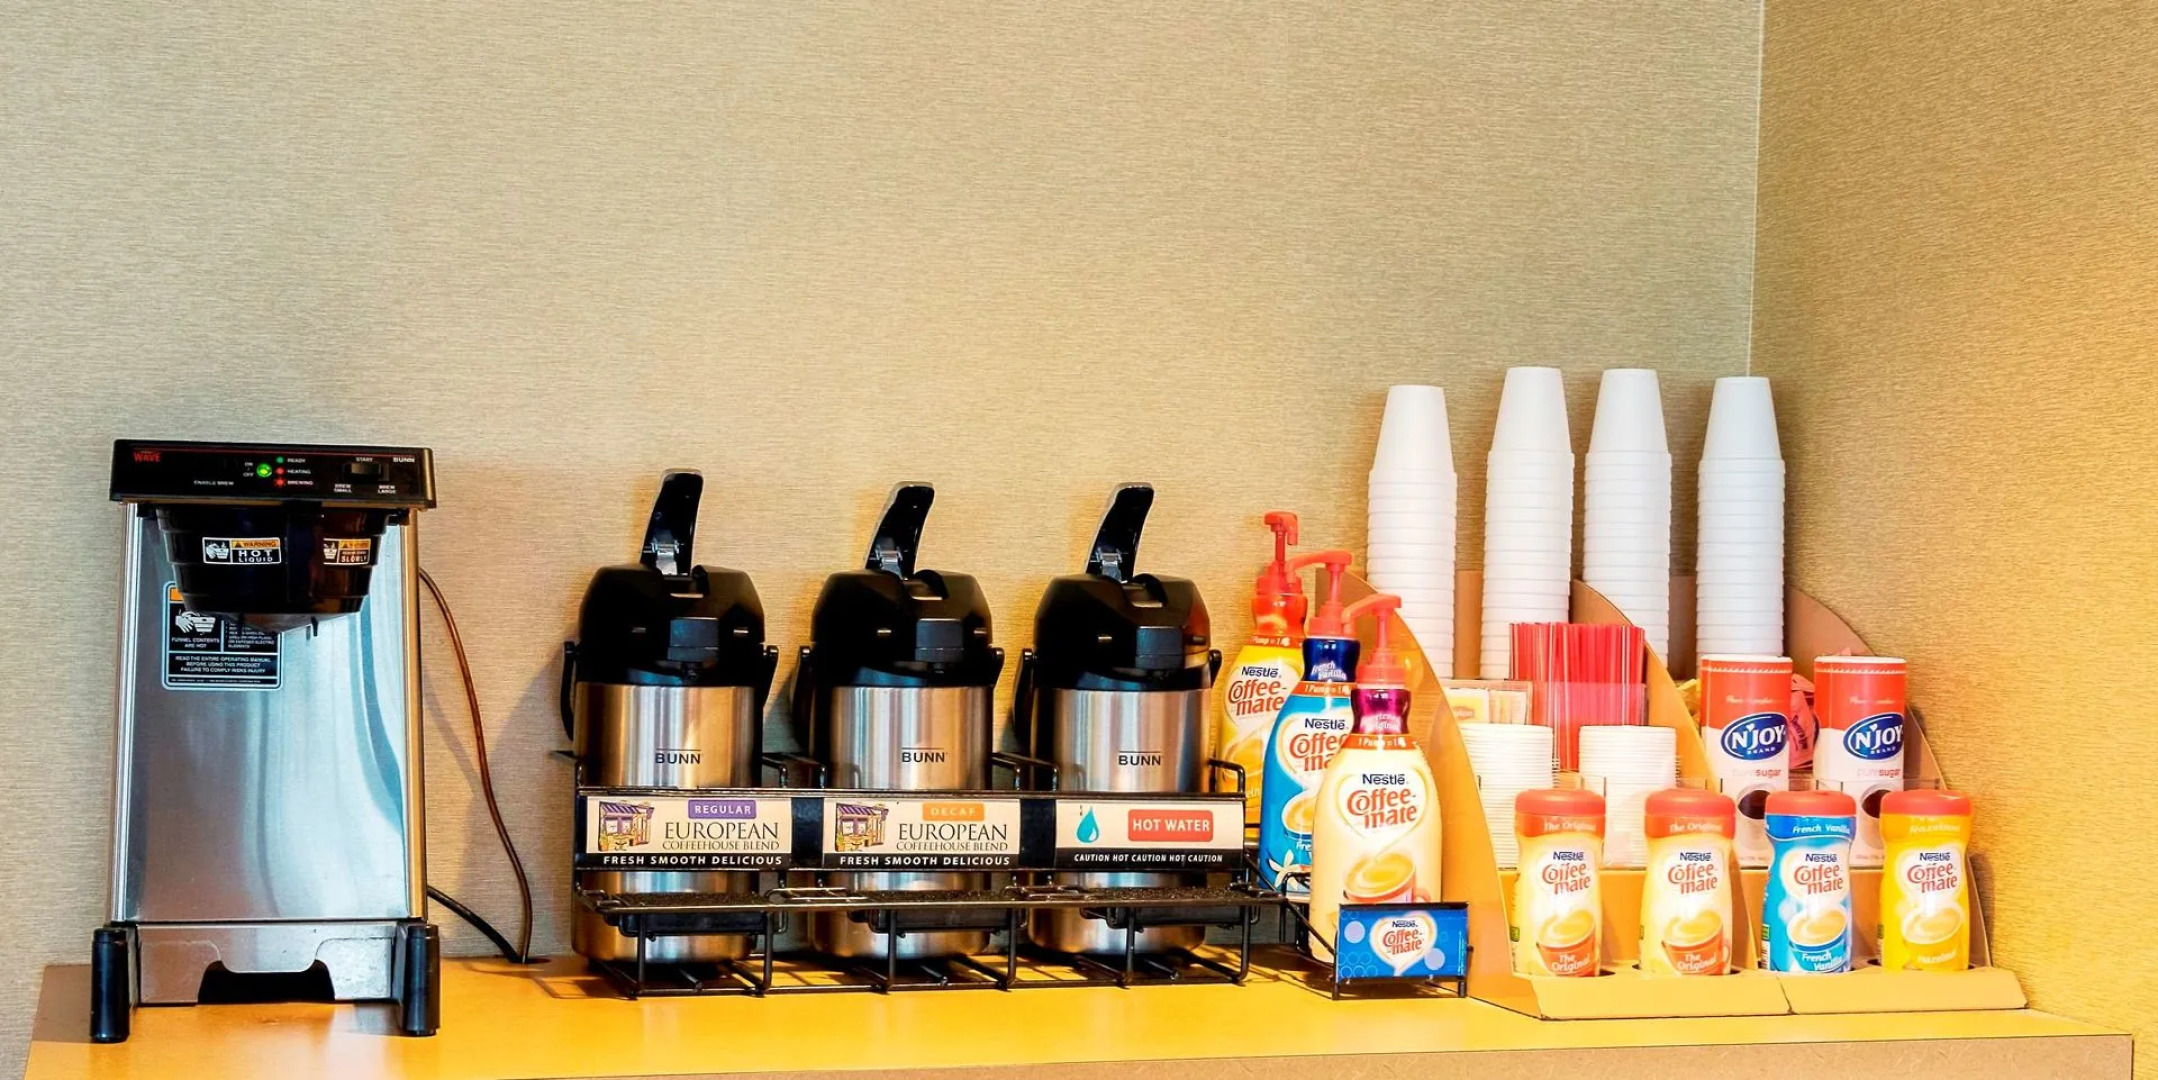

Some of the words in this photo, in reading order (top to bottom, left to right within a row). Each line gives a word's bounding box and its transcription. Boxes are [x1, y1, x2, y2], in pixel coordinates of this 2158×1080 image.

[134, 452, 161, 462] WAVE
[238, 549, 273, 557] HOT
[1241, 666, 1279, 678] Nestlé
[1236, 696, 1285, 716] mate
[1304, 717, 1346, 730] Nestlé
[655, 753, 701, 764] BUNN
[901, 751, 945, 763] BUNN
[1118, 754, 1161, 766] BUNN
[1362, 773, 1405, 785] Nestlé
[694, 805, 751, 814] REGULAR
[1364, 804, 1418, 829] mate
[665, 822, 778, 839] EUROPEAN
[1132, 819, 1161, 831] HOT
[1165, 819, 1210, 832] WATER
[1793, 824, 1821, 834] French
[899, 823, 1007, 840] EUROPEAN
[662, 841, 740, 850] COFFEEHOUSE
[743, 841, 780, 850] BLEND
[896, 842, 971, 851] COFFEEHOUSE
[973, 842, 1008, 851] BLEND
[603, 856, 644, 865] FRESH
[650, 856, 706, 865] SMOOTH
[711, 856, 783, 865] DELICIOUS
[840, 856, 879, 865] FRESH
[884, 856, 937, 865] SMOOTH
[943, 857, 1010, 866] DELICIOUS
[1074, 853, 1110, 862] CAUTION
[1112, 854, 1129, 862] HOT
[1131, 854, 1167, 862] CAUTION
[1169, 854, 1186, 862] HOT
[1187, 854, 1223, 863] CAUTION
[1552, 852, 1584, 861] Nestlé
[1679, 852, 1712, 861] Nestlé
[1805, 853, 1837, 862] Nestlé
[1919, 852, 1951, 862] Nestlé
[1554, 875, 1591, 895] mate
[1680, 875, 1718, 895] mate
[1807, 876, 1843, 895] mate
[1921, 875, 1957, 893] mate
[1391, 919, 1417, 928] Nestlé
[1391, 939, 1423, 955] mate
[1559, 953, 1575, 963] The
[1684, 952, 1700, 962] The
[1801, 951, 1831, 963] French
